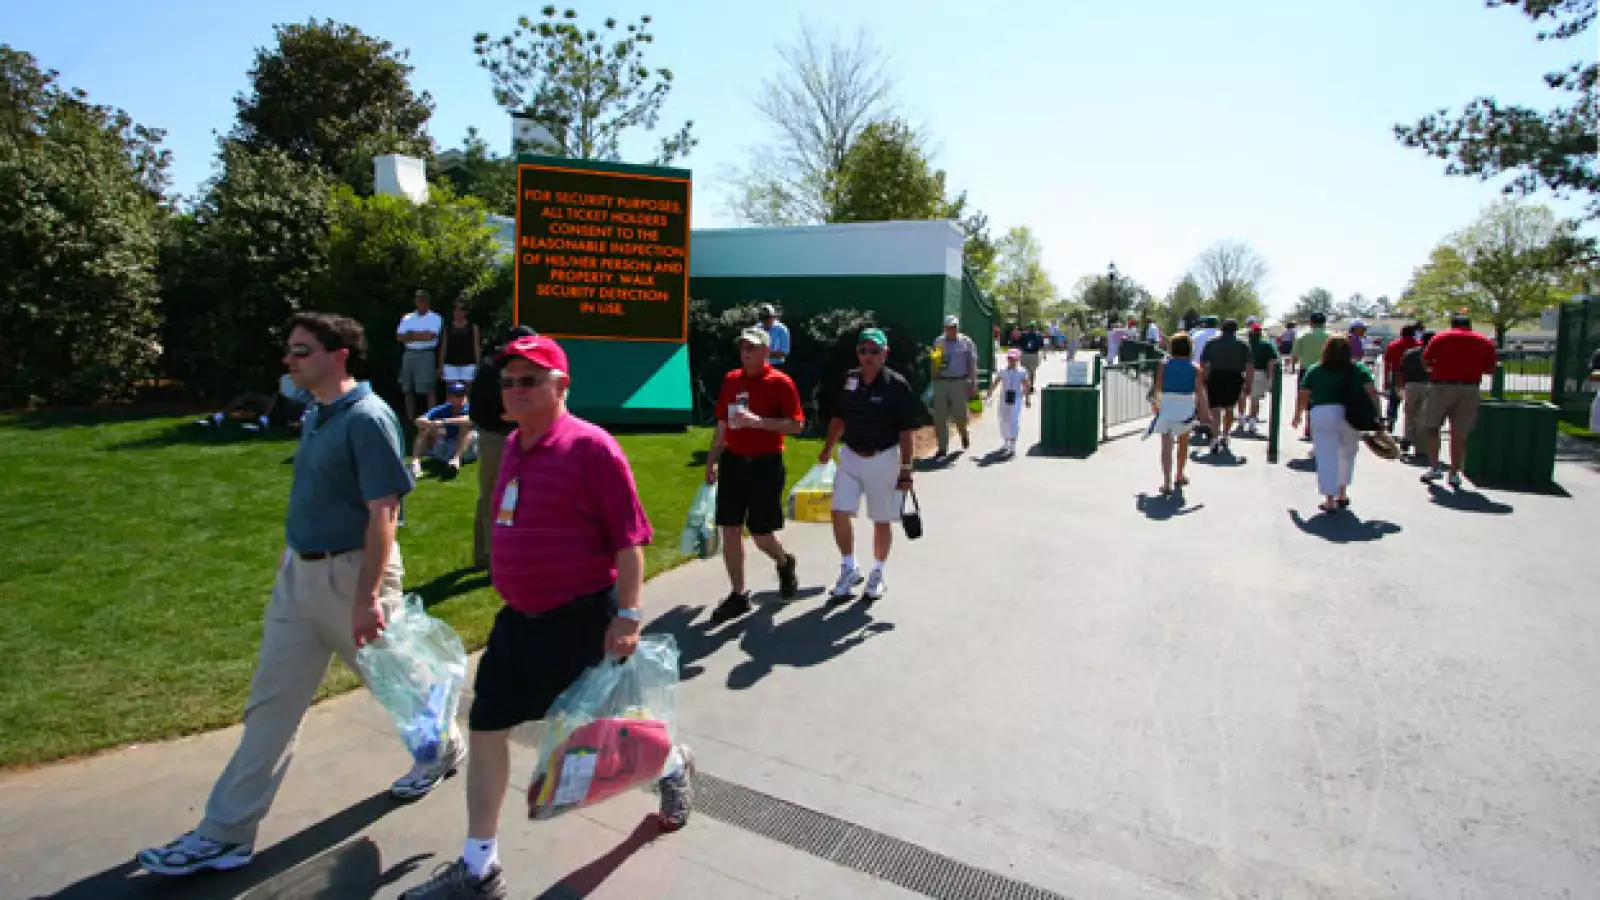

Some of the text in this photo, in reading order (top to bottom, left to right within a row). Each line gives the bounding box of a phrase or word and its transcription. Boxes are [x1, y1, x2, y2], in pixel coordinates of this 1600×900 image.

[556, 191, 613, 208] SECURITY
[541, 207, 668, 227] ALL TICKET HOLDERS
[549, 222, 660, 242] CONSENT TO THE
[522, 235, 684, 257] REASONABLE INSPECTION
[522, 253, 541, 265] OF
[600, 258, 651, 272] PERSON
[654, 261, 683, 275] AND
[536, 284, 669, 302] SECURITY DETECTION
[579, 302, 595, 314] IN
